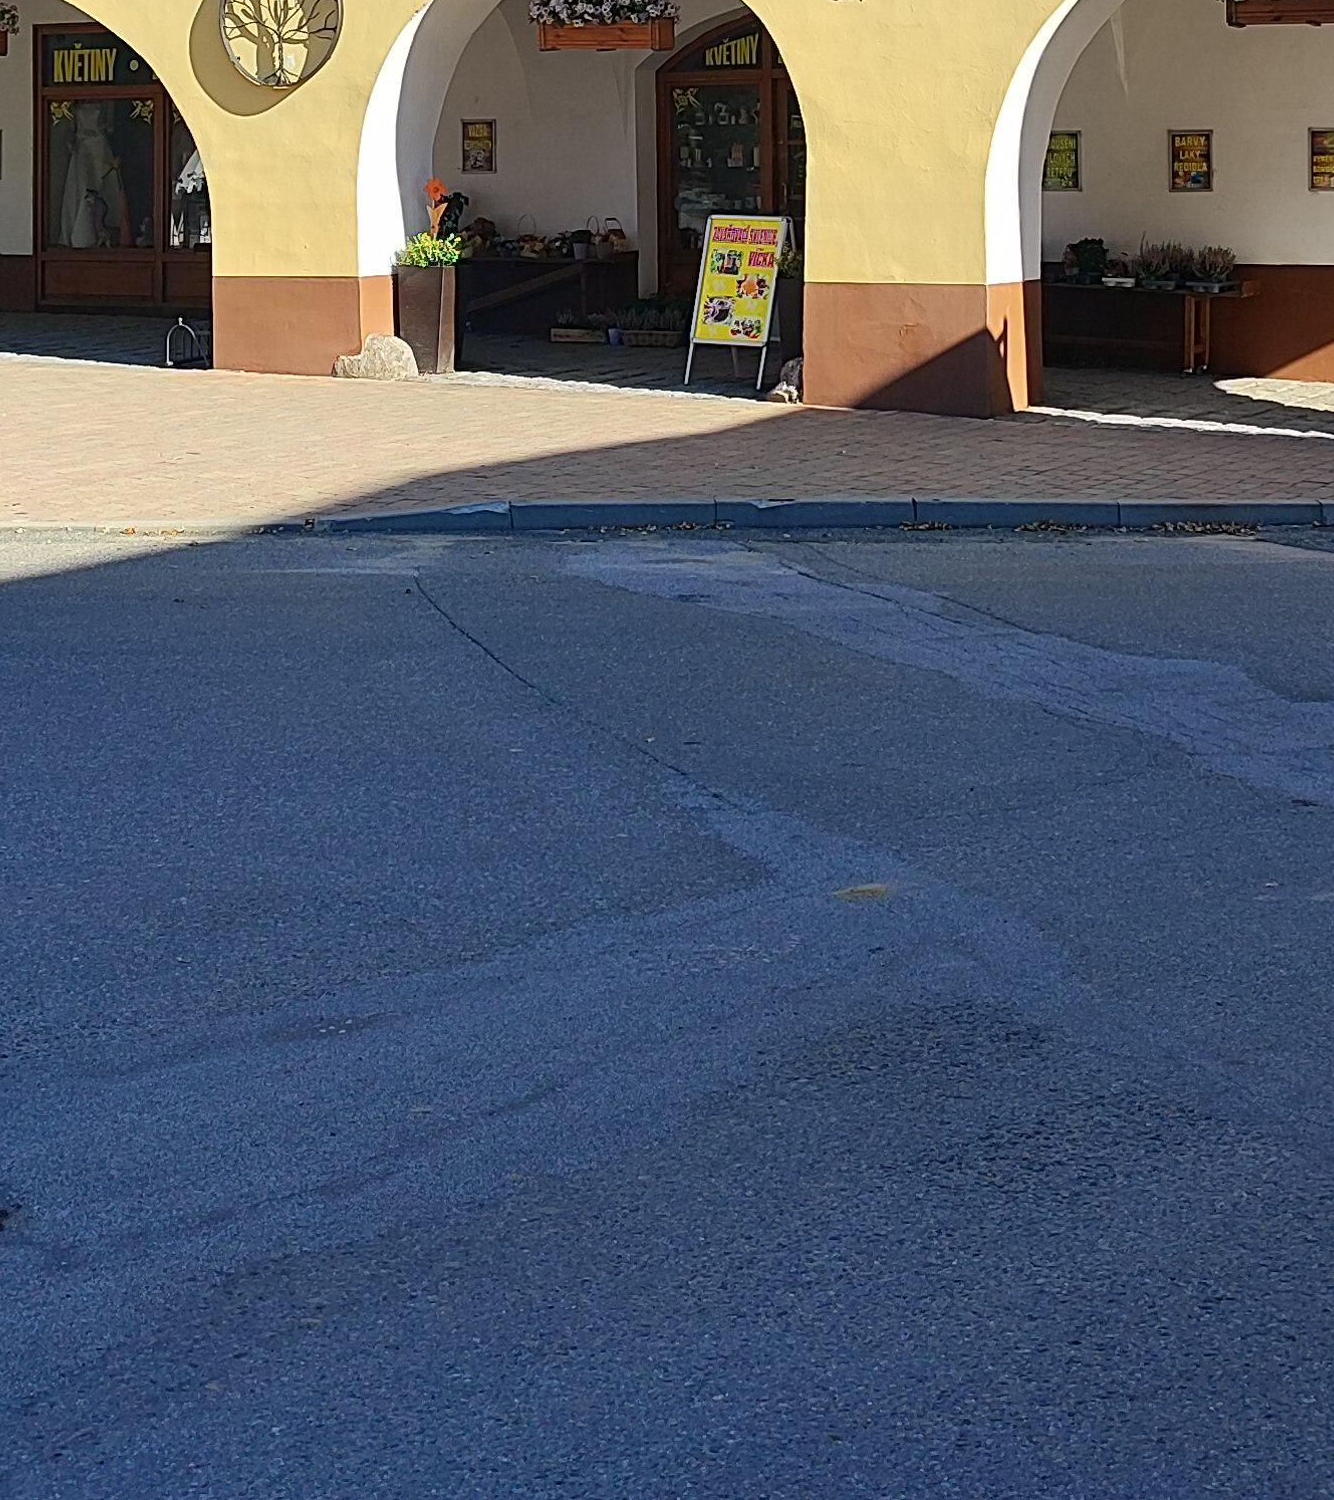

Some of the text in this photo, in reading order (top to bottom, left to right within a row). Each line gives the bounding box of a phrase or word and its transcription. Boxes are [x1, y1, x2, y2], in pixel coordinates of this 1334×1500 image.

[705, 33, 759, 66] KVĚTINY
[53, 42, 117, 82] KVĚTINY
[1175, 136, 1206, 147] BARVY
[1179, 149, 1201, 160] LAKY
